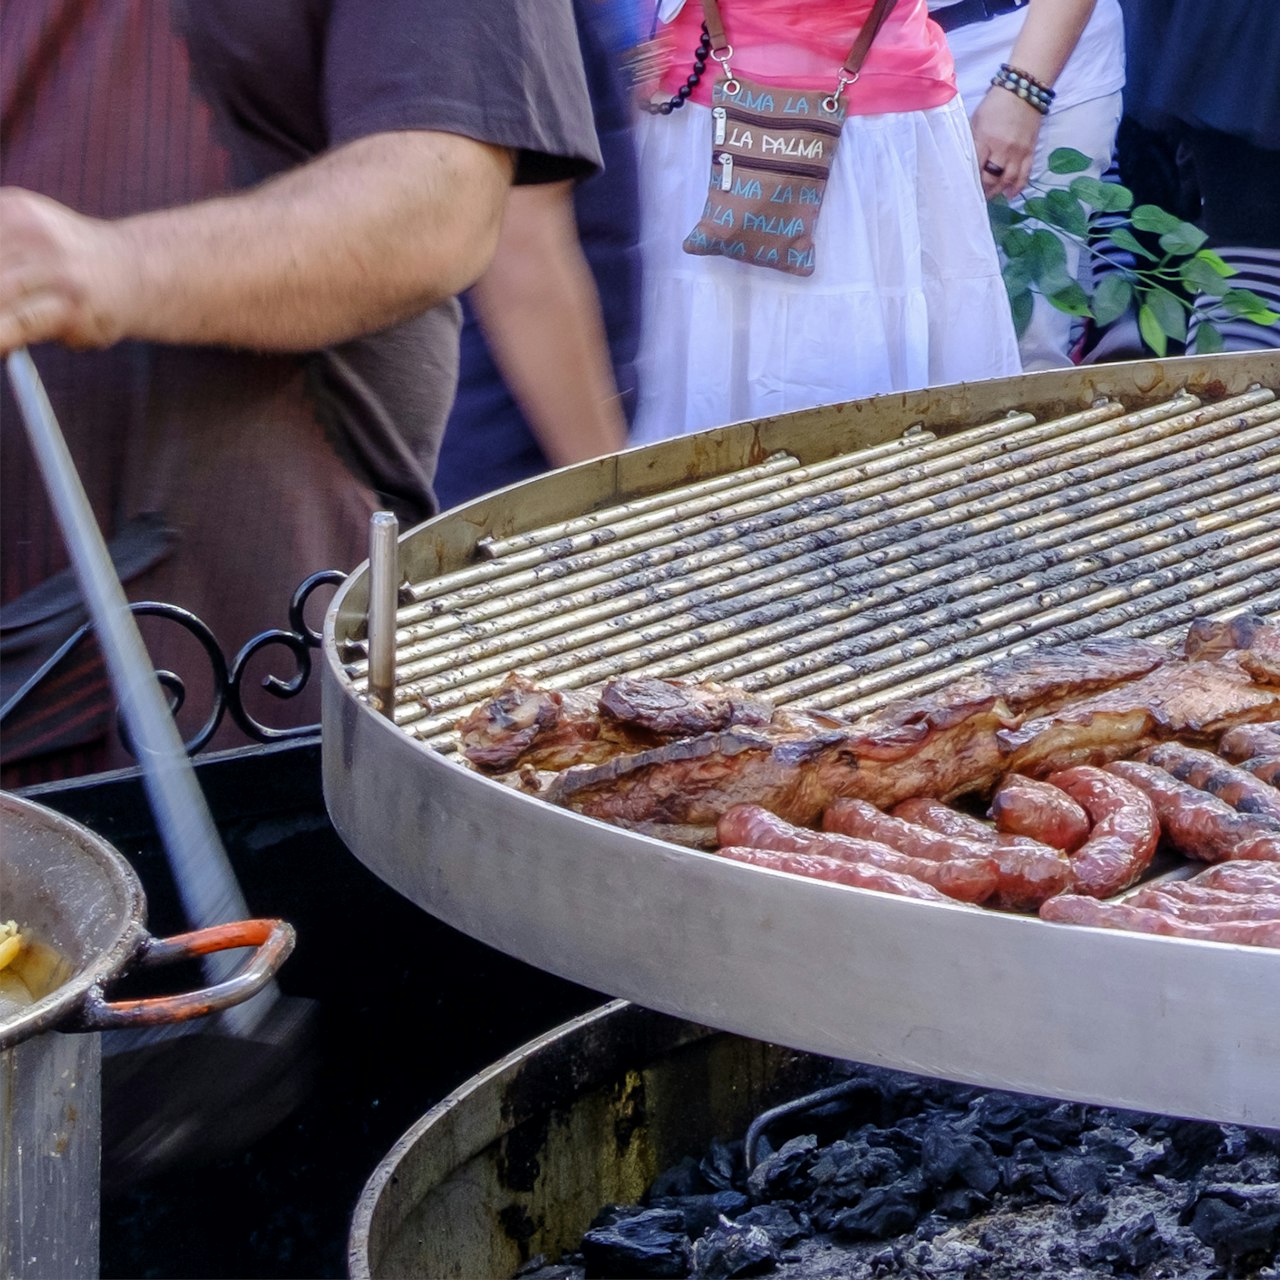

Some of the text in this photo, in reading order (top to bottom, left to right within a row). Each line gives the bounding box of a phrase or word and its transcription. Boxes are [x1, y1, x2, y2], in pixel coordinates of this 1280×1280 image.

[783, 96, 809, 114] LA
[728, 128, 823, 159] LA PALMA
[770, 184, 793, 204] LA
[713, 204, 735, 228] LA
[743, 211, 805, 238] PALMA
[754, 245, 780, 263] LA
